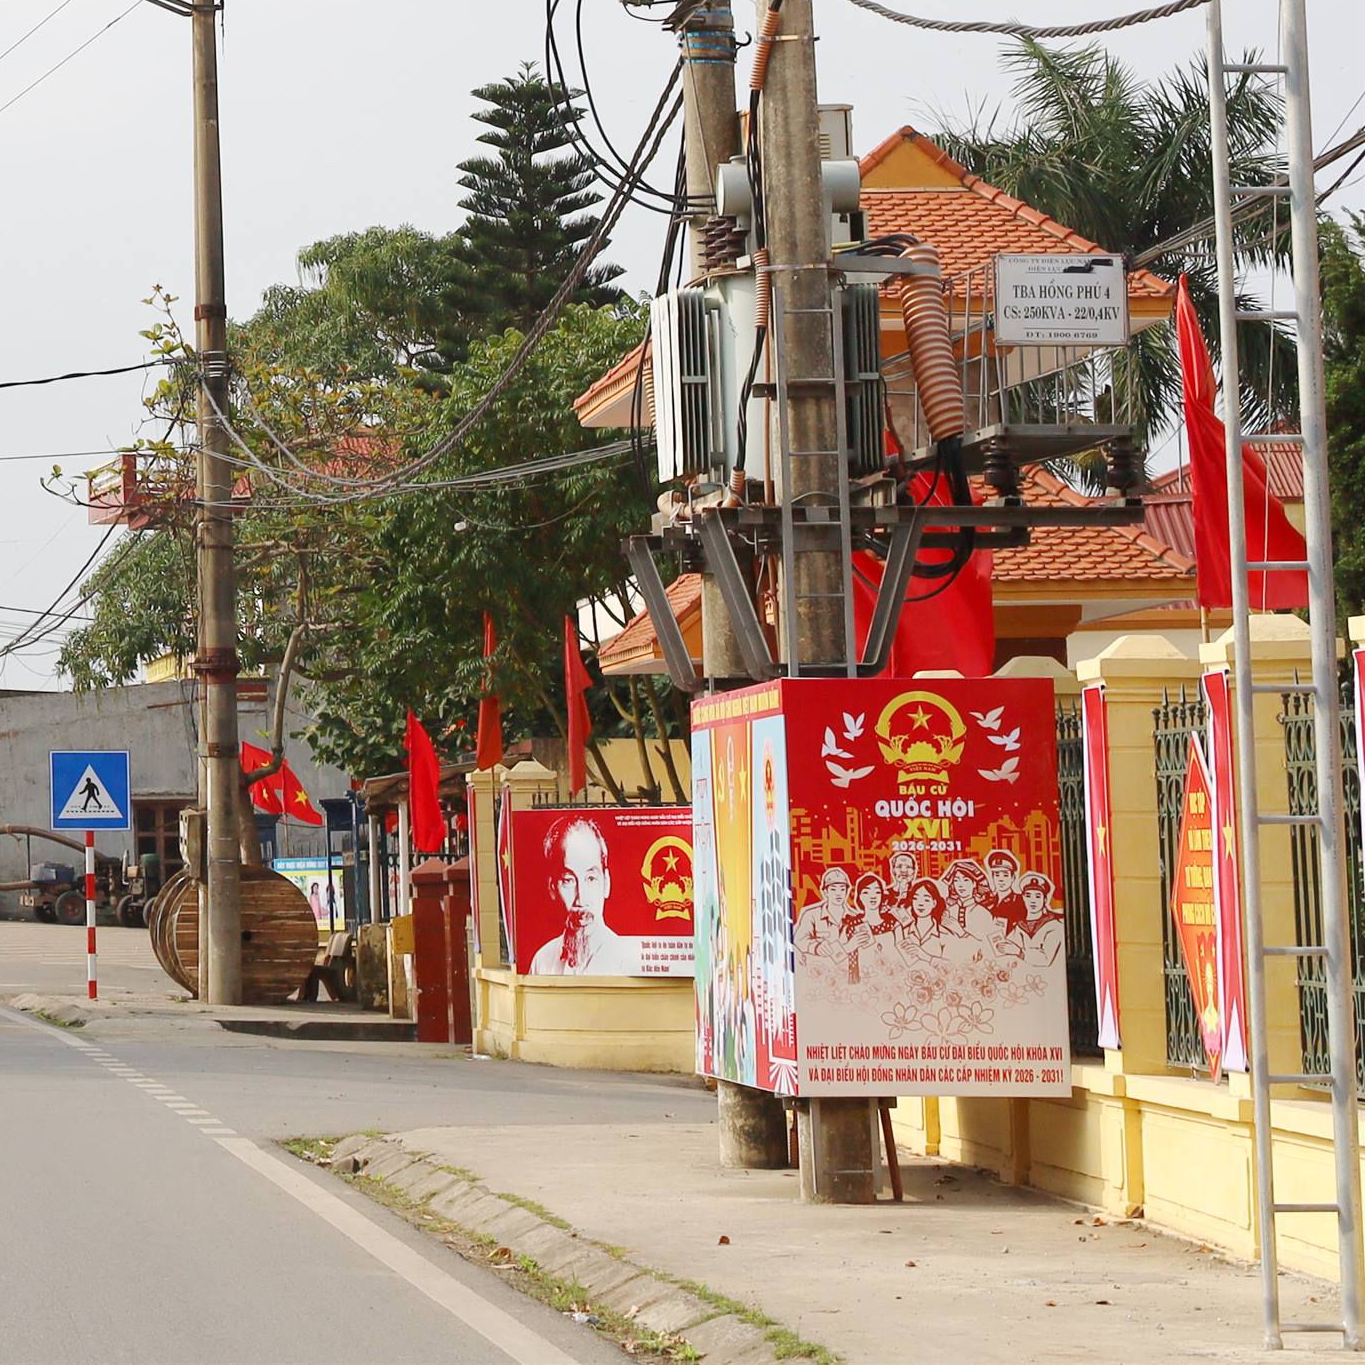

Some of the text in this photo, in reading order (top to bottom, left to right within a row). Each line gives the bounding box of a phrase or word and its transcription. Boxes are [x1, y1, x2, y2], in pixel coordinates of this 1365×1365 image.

[1013, 285, 1036, 299] TBA
[1077, 281, 1102, 300] PHÚ
[1104, 286, 1110, 299] 4
[1004, 305, 1021, 320] CS:
[1024, 306, 1066, 320] 250KVA
[1074, 306, 1120, 322] 22/0,4KV
[874, 796, 975, 822] QUỐC HỘI
[902, 819, 951, 839] XVI
[891, 840, 963, 852] 2026-2031
[806, 1043, 829, 1063] NHIỆT
[831, 1043, 847, 1063] LIỆT
[849, 1042, 870, 1060] CHÀO
[872, 1042, 896, 1060] MỪNG
[898, 1043, 919, 1060] NGÀY
[921, 1041, 937, 1060] BẦU
[952, 1046, 966, 1064] ĐẠI
[967, 1040, 986, 1061] BIỂU
[987, 1042, 1009, 1062] QUỐC
[1011, 1044, 1025, 1064] HỘI
[1026, 1044, 1048, 1061] KHÓA
[1049, 1047, 1063, 1061] XVI
[808, 1065, 819, 1082] VÀ
[821, 1067, 834, 1085] ĐẠI
[836, 1062, 855, 1082] BIỂU
[856, 1065, 870, 1085] HỘI
[871, 1063, 894, 1082] ĐỒNG
[895, 1065, 918, 1082] NHÂN
[919, 1065, 936, 1082] DÂN
[938, 1065, 954, 1083] CÁC
[956, 1064, 972, 1083] CẤP
[974, 1065, 1000, 1087] NHIỆM
[1002, 1065, 1012, 1083] KỲ
[1015, 1069, 1034, 1083] 2026
